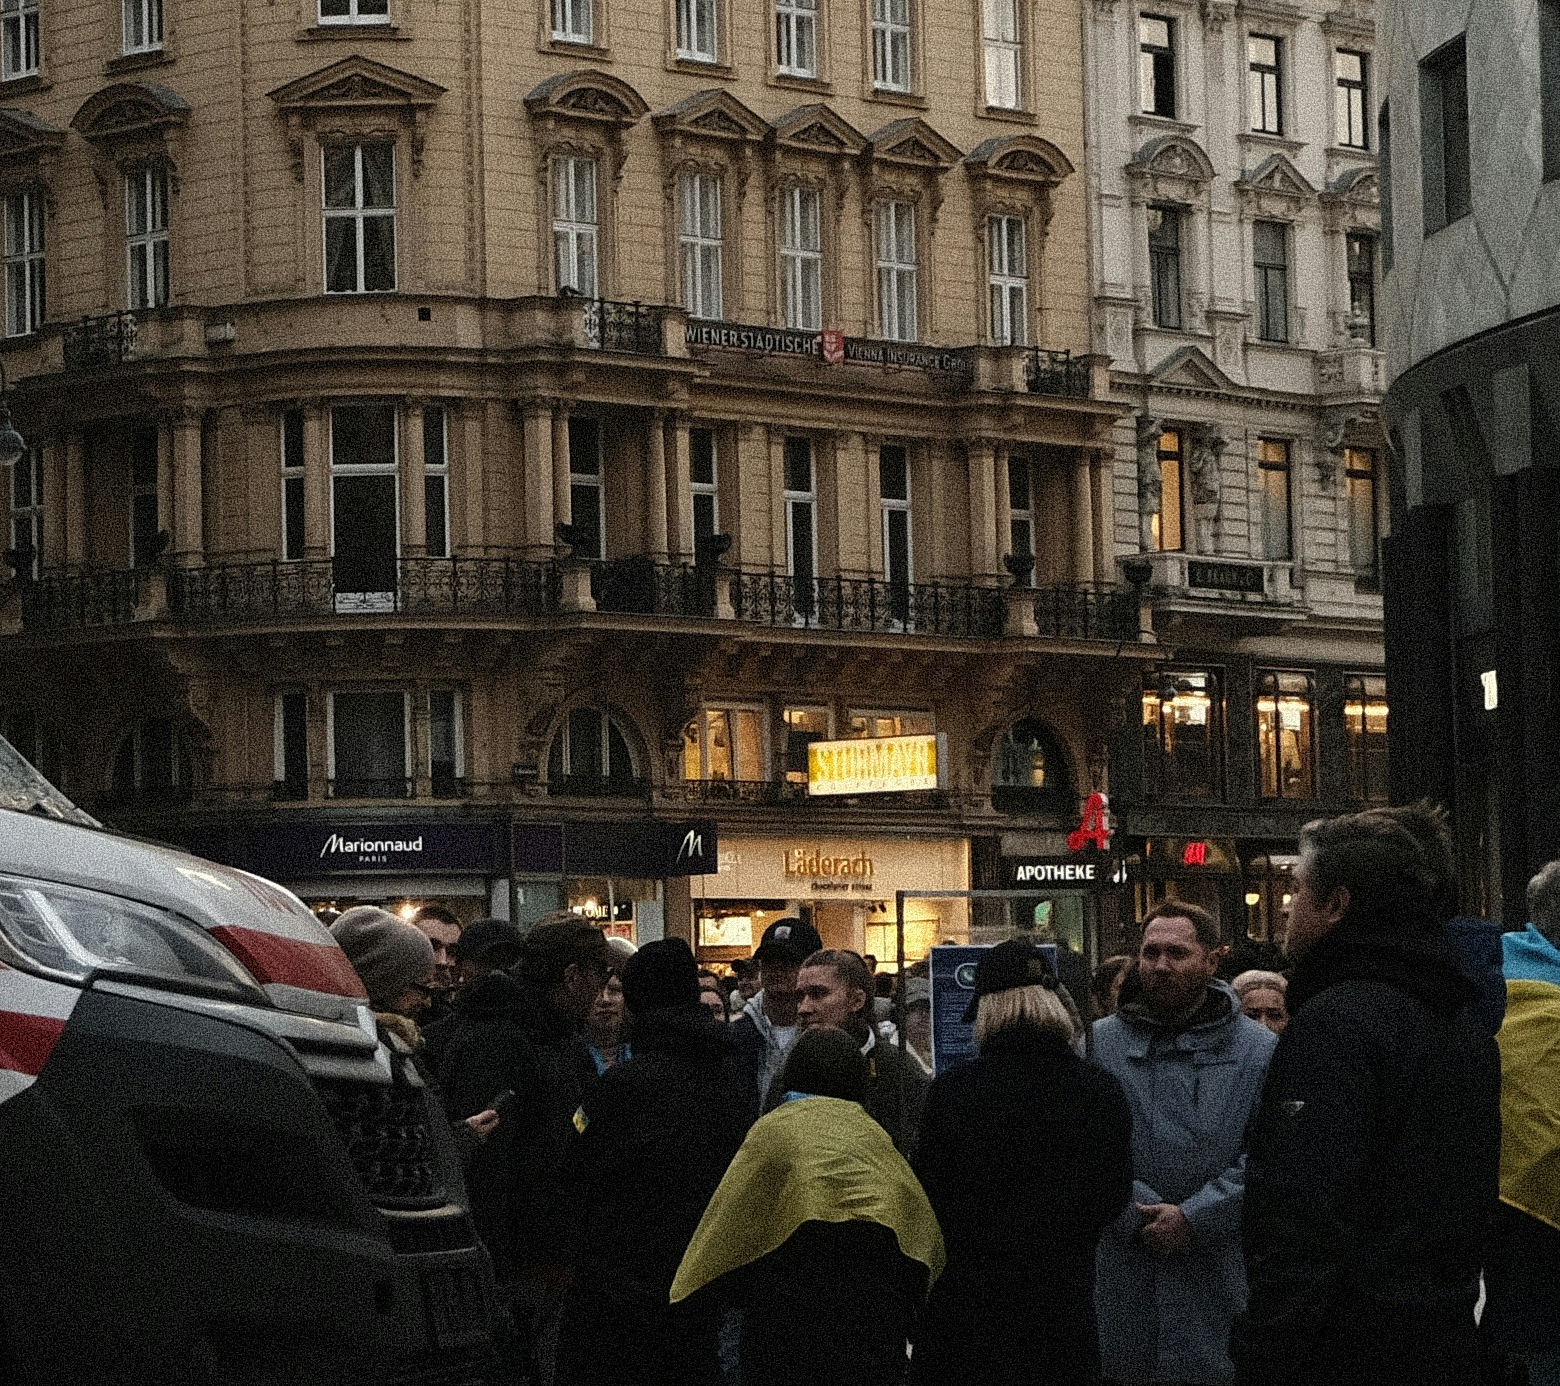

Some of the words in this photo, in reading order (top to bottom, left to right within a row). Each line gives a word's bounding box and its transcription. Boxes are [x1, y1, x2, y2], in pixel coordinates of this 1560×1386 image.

[684, 325, 737, 349] WIENER
[319, 832, 423, 859] Marionnaud
[358, 854, 388, 863] PARIS
[783, 849, 874, 877] Läderach
[1016, 864, 1096, 881] APOTHEKE
